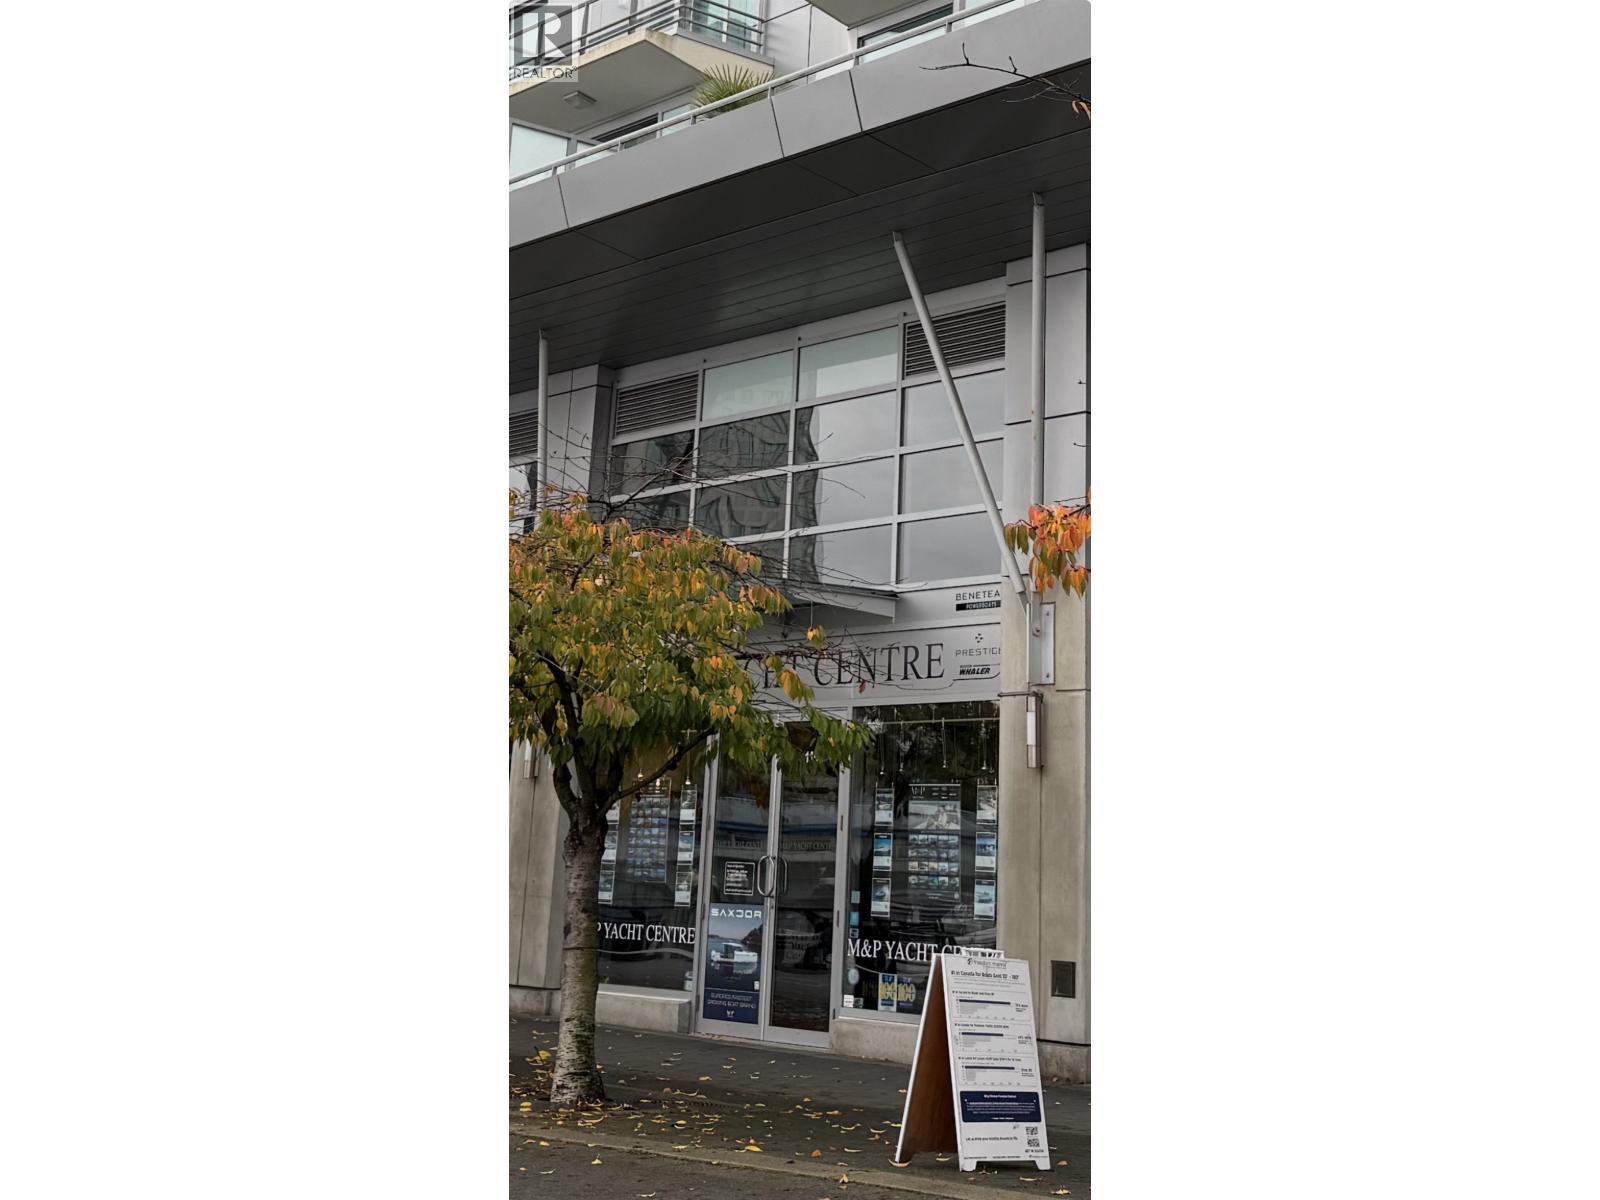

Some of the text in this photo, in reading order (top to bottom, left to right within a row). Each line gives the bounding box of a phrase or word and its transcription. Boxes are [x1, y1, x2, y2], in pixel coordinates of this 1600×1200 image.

[814, 642, 944, 686] CENTRE
[959, 667, 991, 676] WHALER
[604, 922, 644, 940] YACHT
[646, 924, 696, 944] CENTRE
[847, 938, 882, 958] M&P
[885, 940, 938, 961] YACHT
